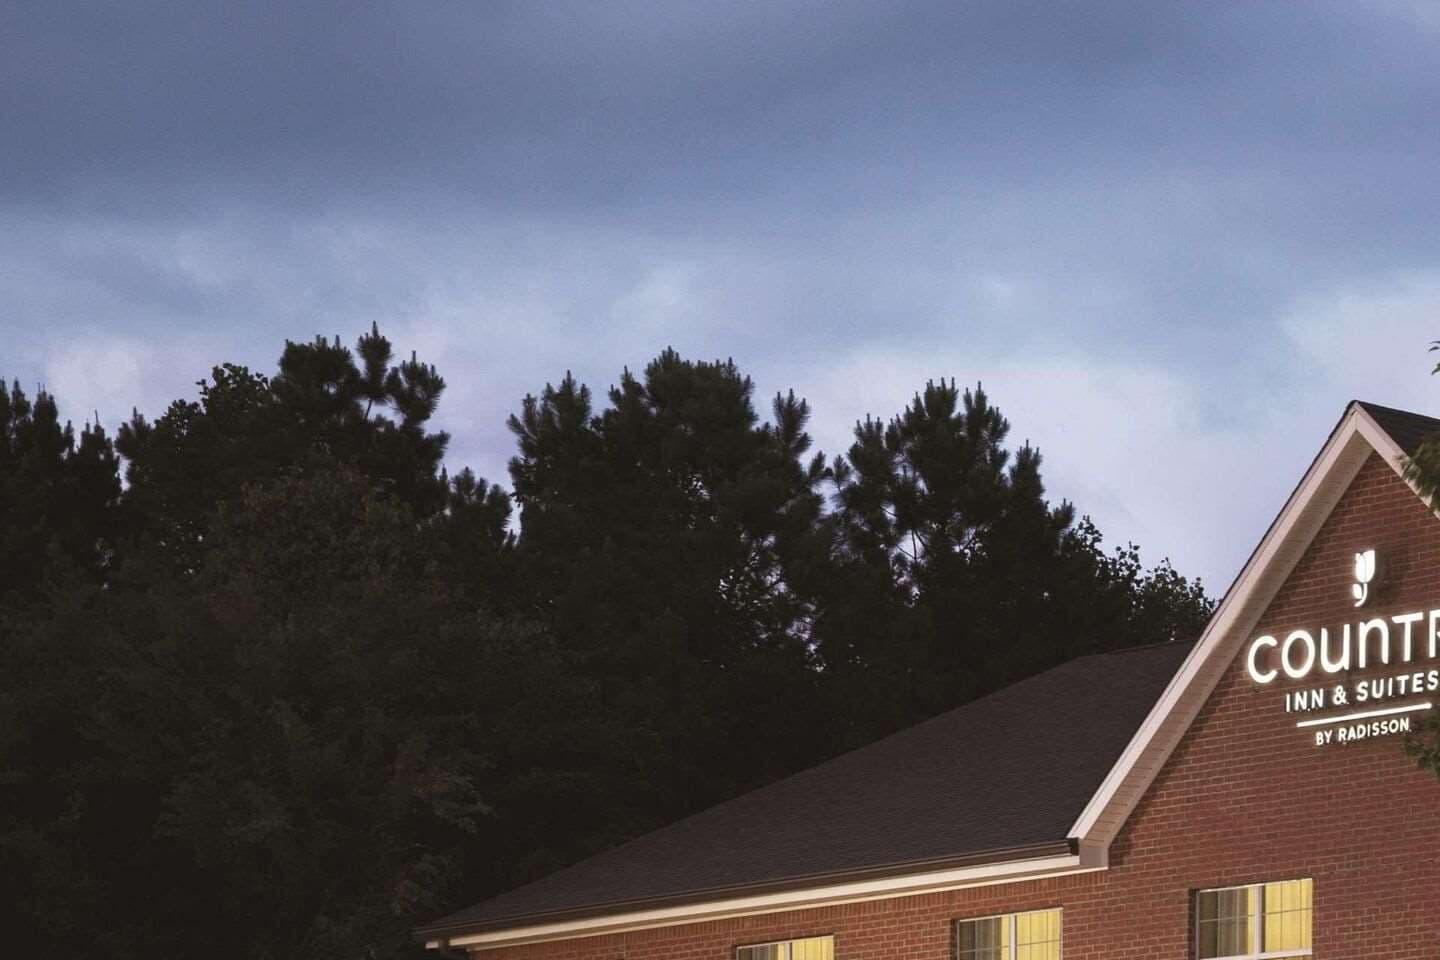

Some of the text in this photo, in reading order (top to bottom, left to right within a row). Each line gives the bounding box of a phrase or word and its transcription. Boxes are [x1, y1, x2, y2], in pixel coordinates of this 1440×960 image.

[1285, 670, 1440, 713] INN & SUITES
[1315, 717, 1410, 746] BY RADISSON
